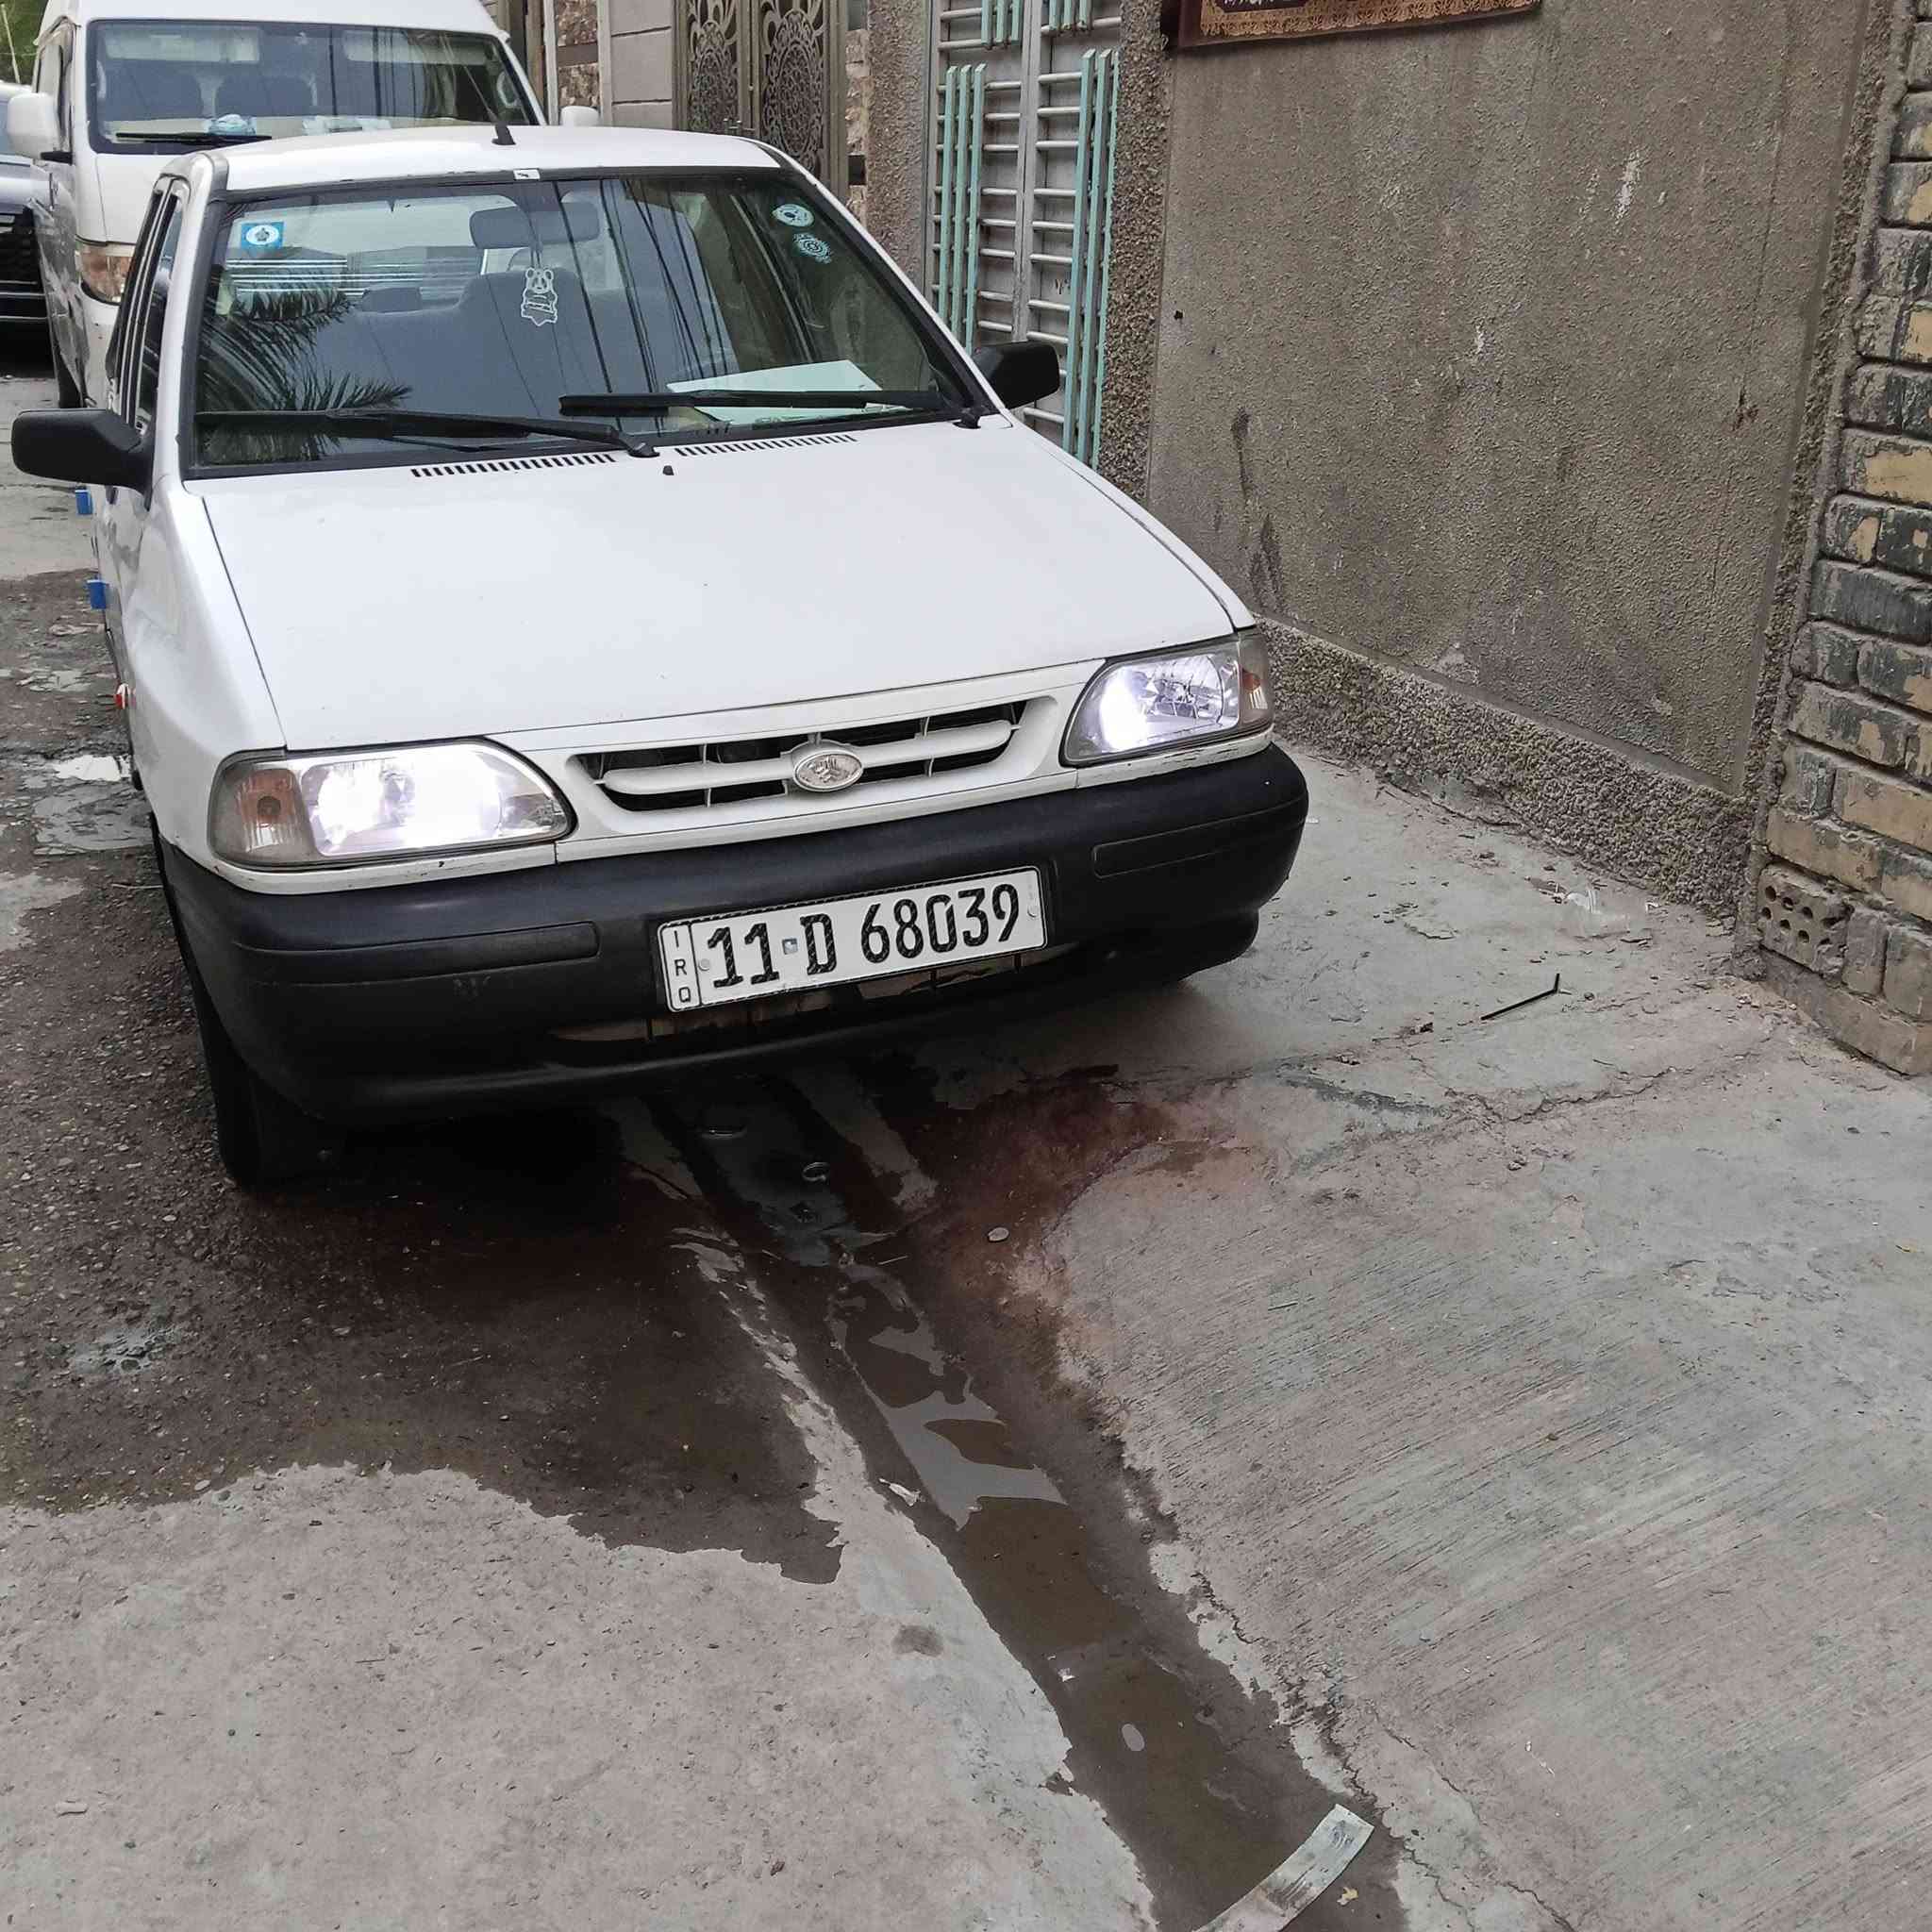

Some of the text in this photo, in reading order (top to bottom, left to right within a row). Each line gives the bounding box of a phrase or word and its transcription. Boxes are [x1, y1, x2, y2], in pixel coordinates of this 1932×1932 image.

[674, 930, 691, 1003] IRQ
[708, 884, 1019, 988] 11 D 68039
